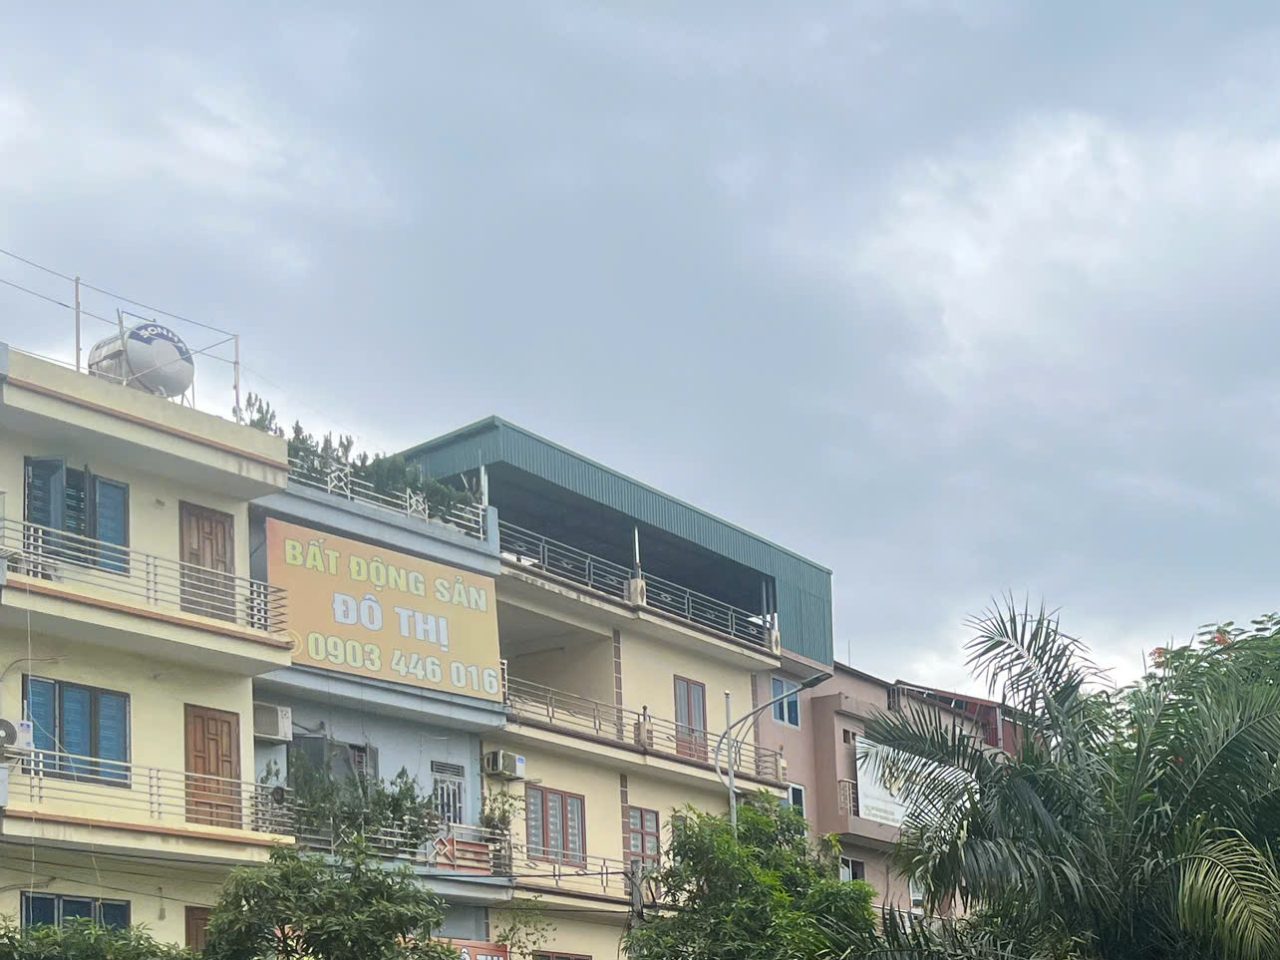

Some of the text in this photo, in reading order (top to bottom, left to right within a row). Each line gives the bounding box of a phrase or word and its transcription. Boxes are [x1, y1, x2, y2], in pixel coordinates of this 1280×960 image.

[284, 539, 488, 612] BẤT ĐỘNG SẢN
[332, 592, 450, 652] ĐÔ THỊ
[307, 631, 499, 695] 0903 446 016
